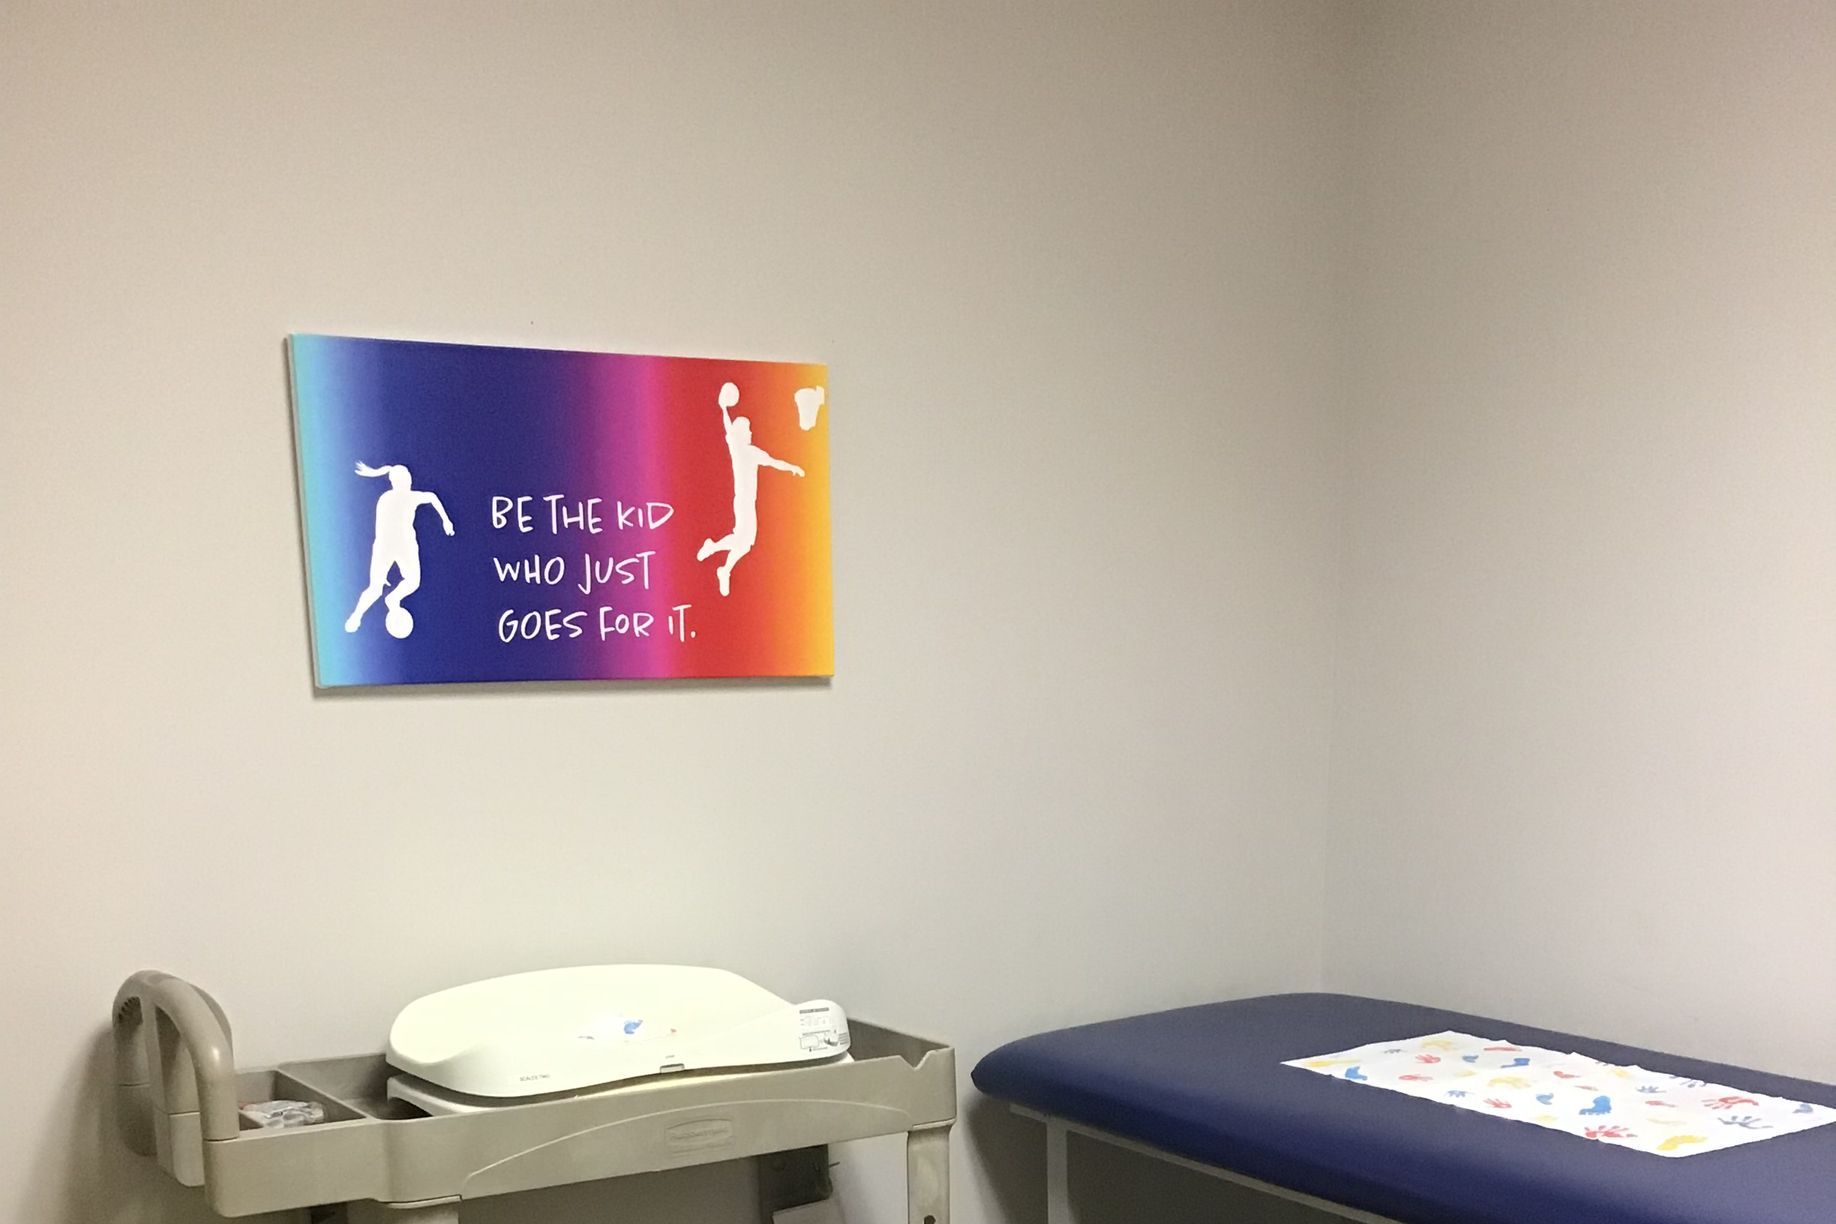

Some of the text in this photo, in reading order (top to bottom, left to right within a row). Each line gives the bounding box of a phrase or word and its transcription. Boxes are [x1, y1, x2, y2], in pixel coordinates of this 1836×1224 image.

[492, 494, 674, 535] BE THE KID
[493, 550, 656, 595] WHO JUST
[498, 604, 696, 643] GOES FOR IT.
